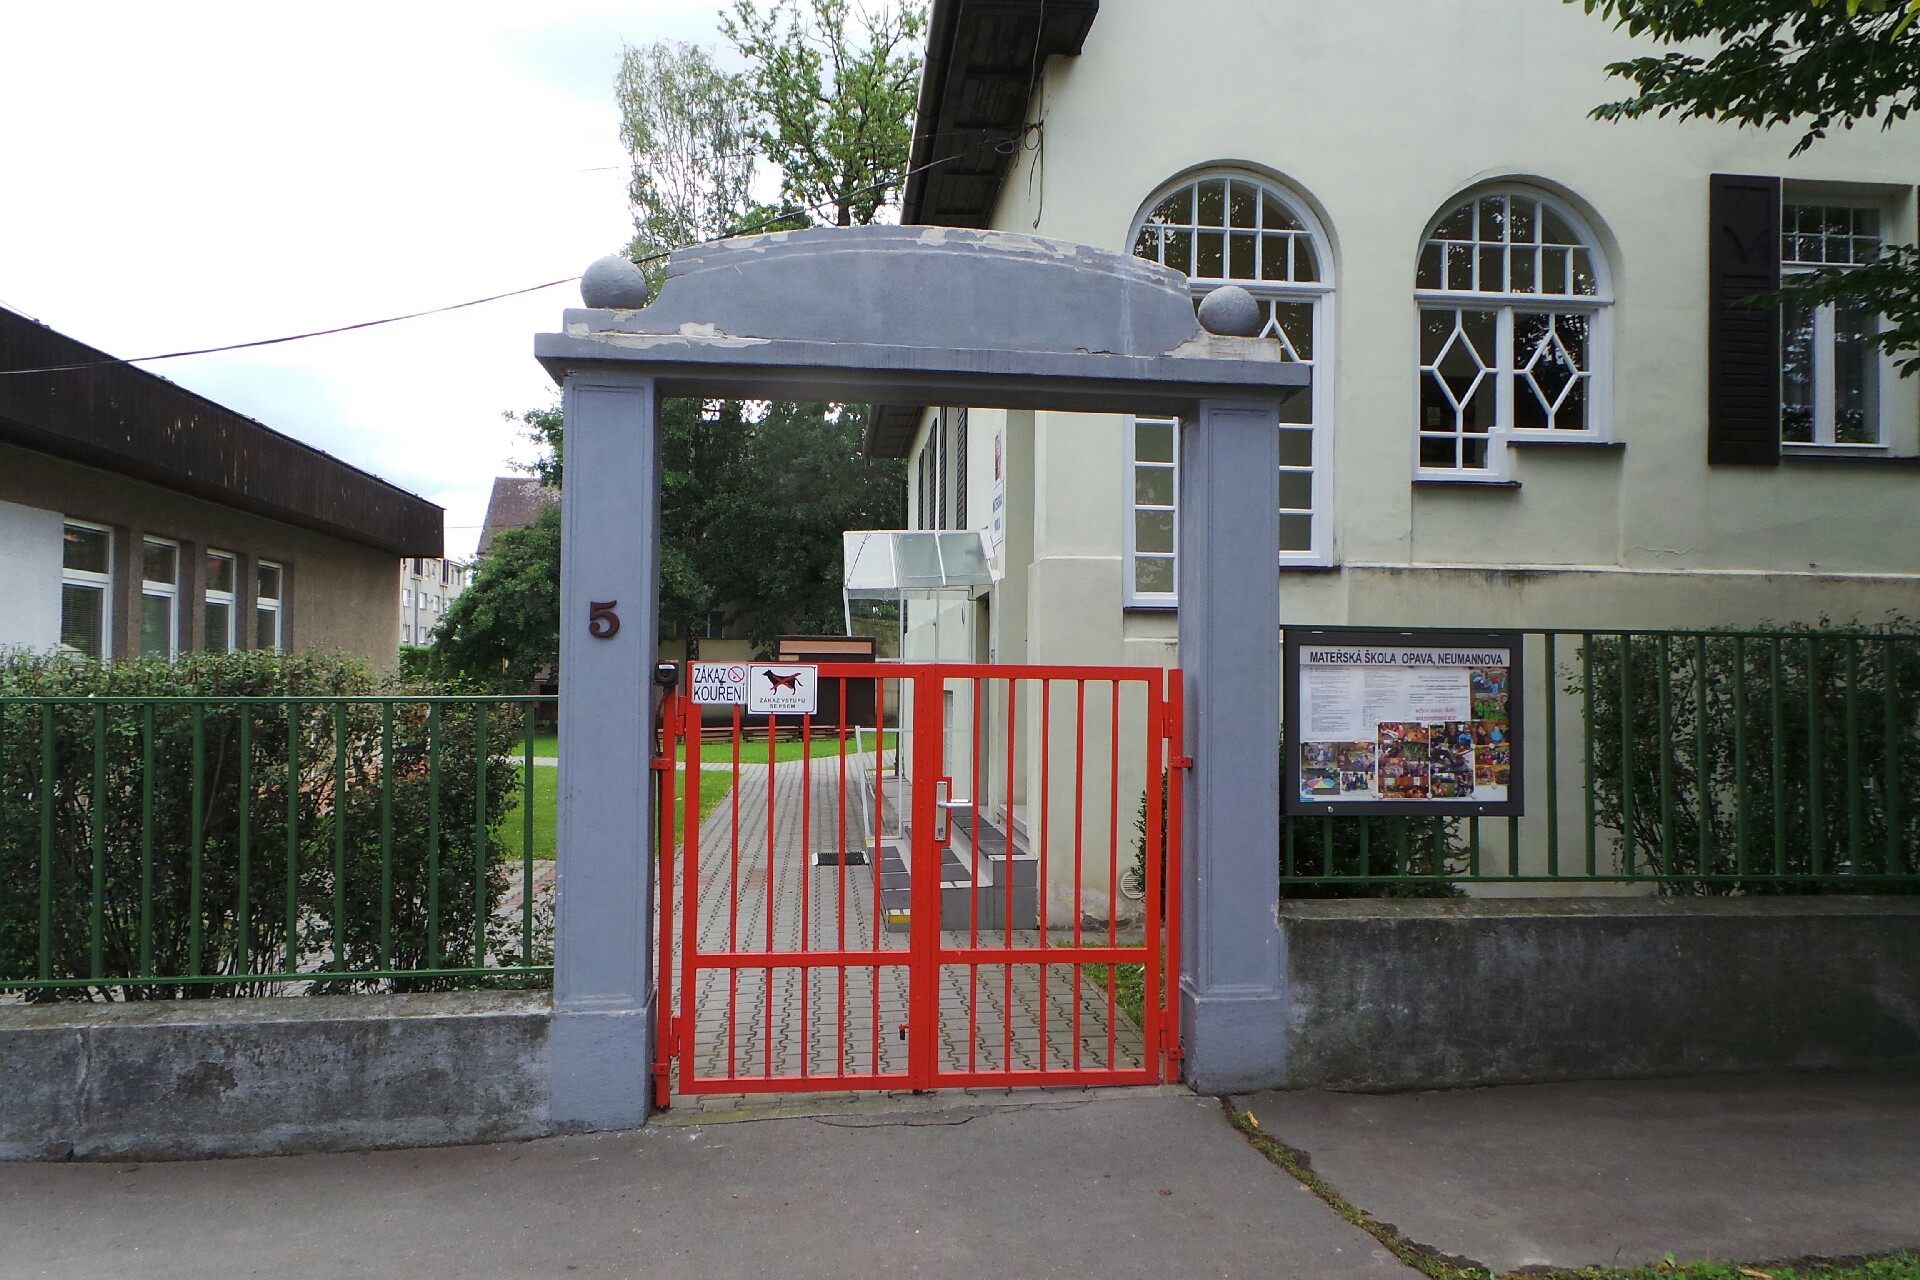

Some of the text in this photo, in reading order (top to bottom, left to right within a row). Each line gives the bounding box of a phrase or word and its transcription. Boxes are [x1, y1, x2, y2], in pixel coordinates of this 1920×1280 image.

[589, 600, 620, 639] 5
[1309, 649, 1504, 666] MATEŘSKÁ ŠKOLA OPAVA, NEUMANNOVA
[694, 665, 726, 683] ZÁKAZ
[694, 683, 745, 701] KOUŘENÍ
